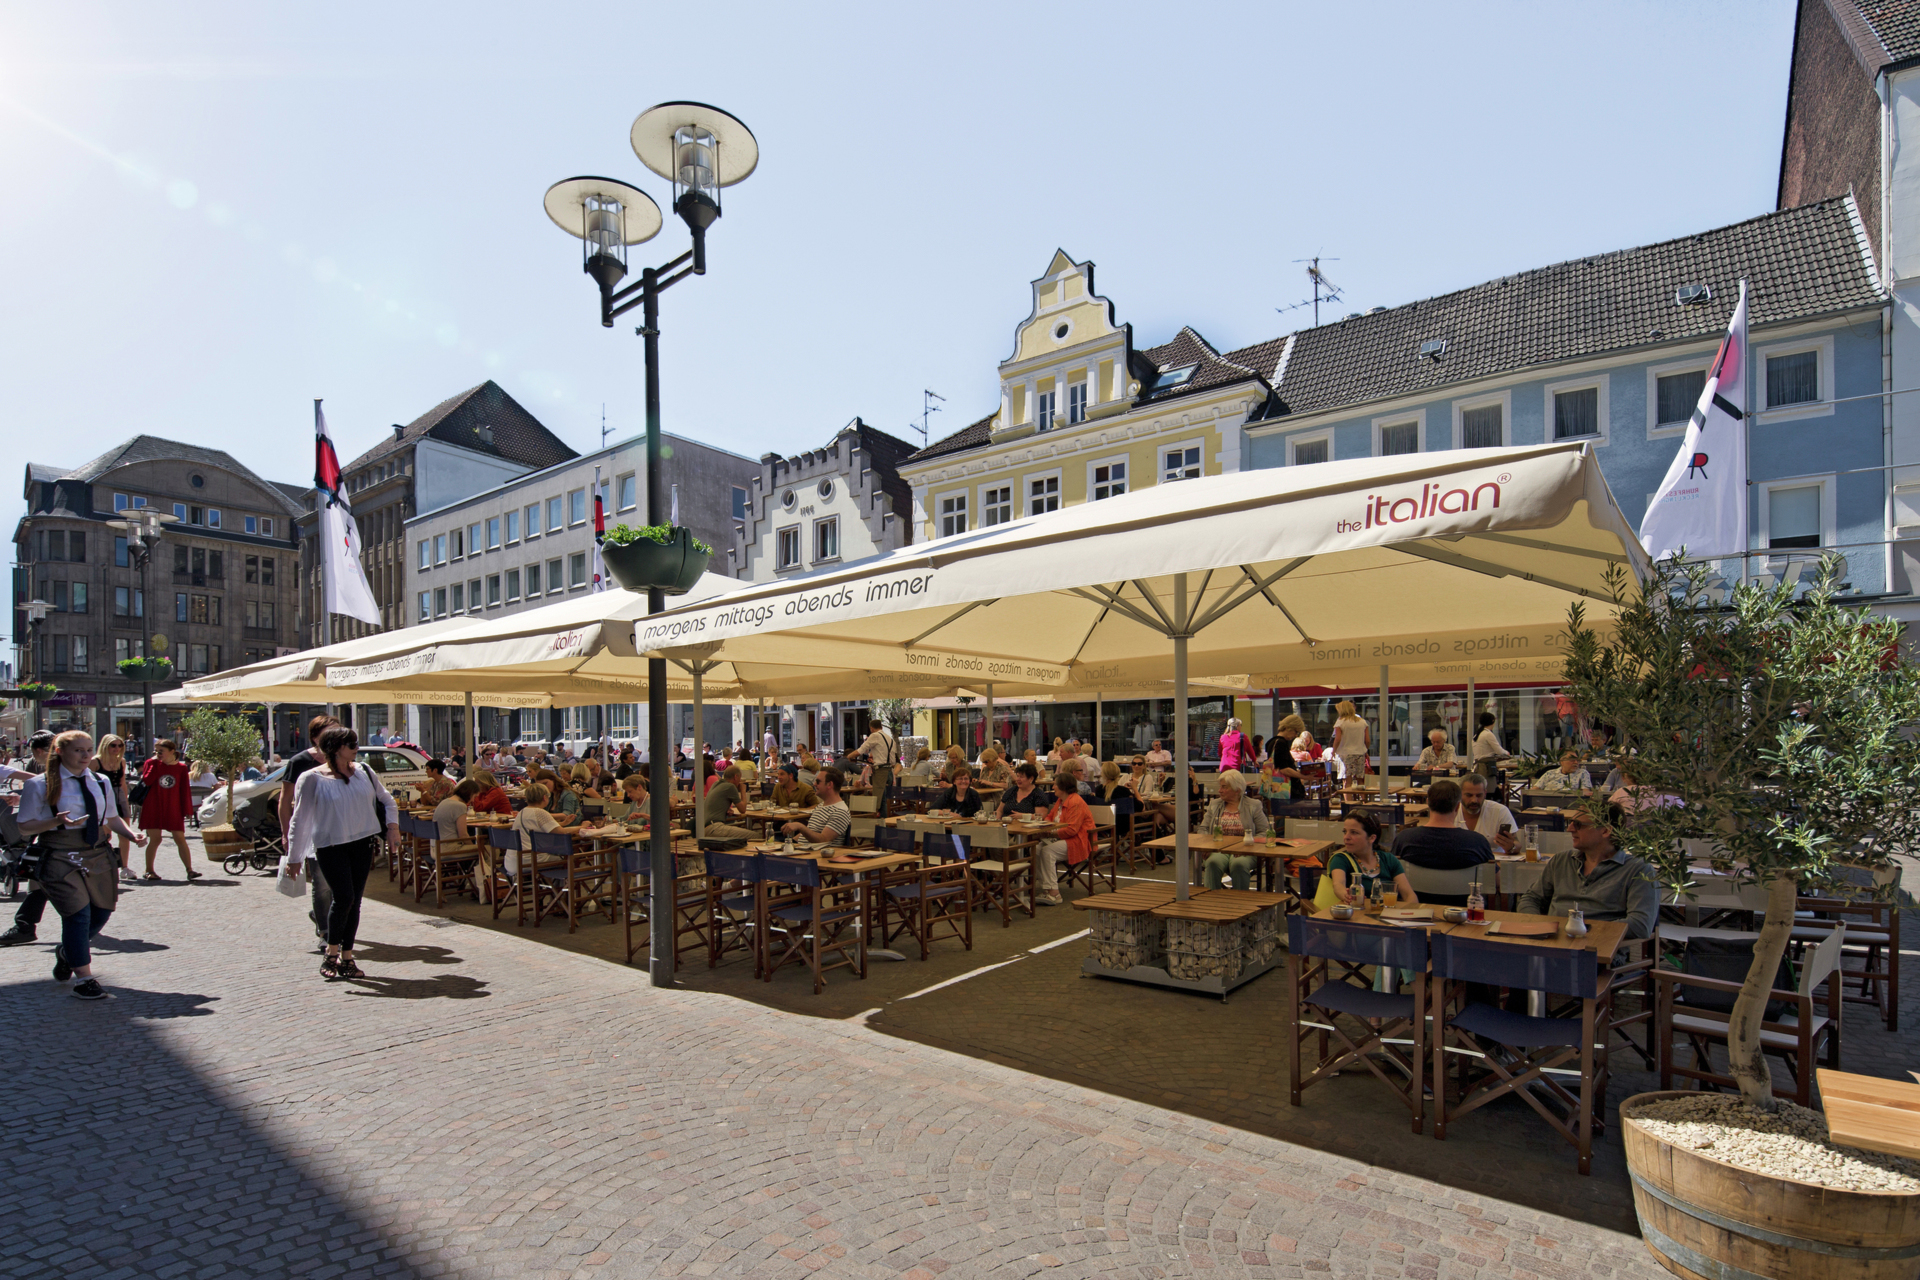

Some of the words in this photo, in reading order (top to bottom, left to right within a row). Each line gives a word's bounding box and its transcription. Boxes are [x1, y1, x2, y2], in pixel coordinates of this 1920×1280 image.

[1336, 518, 1362, 534] the
[643, 616, 707, 640] morgens
[714, 604, 775, 627] mittags
[785, 585, 854, 616] abends
[865, 574, 934, 602] immer
[328, 668, 359, 682] morgens
